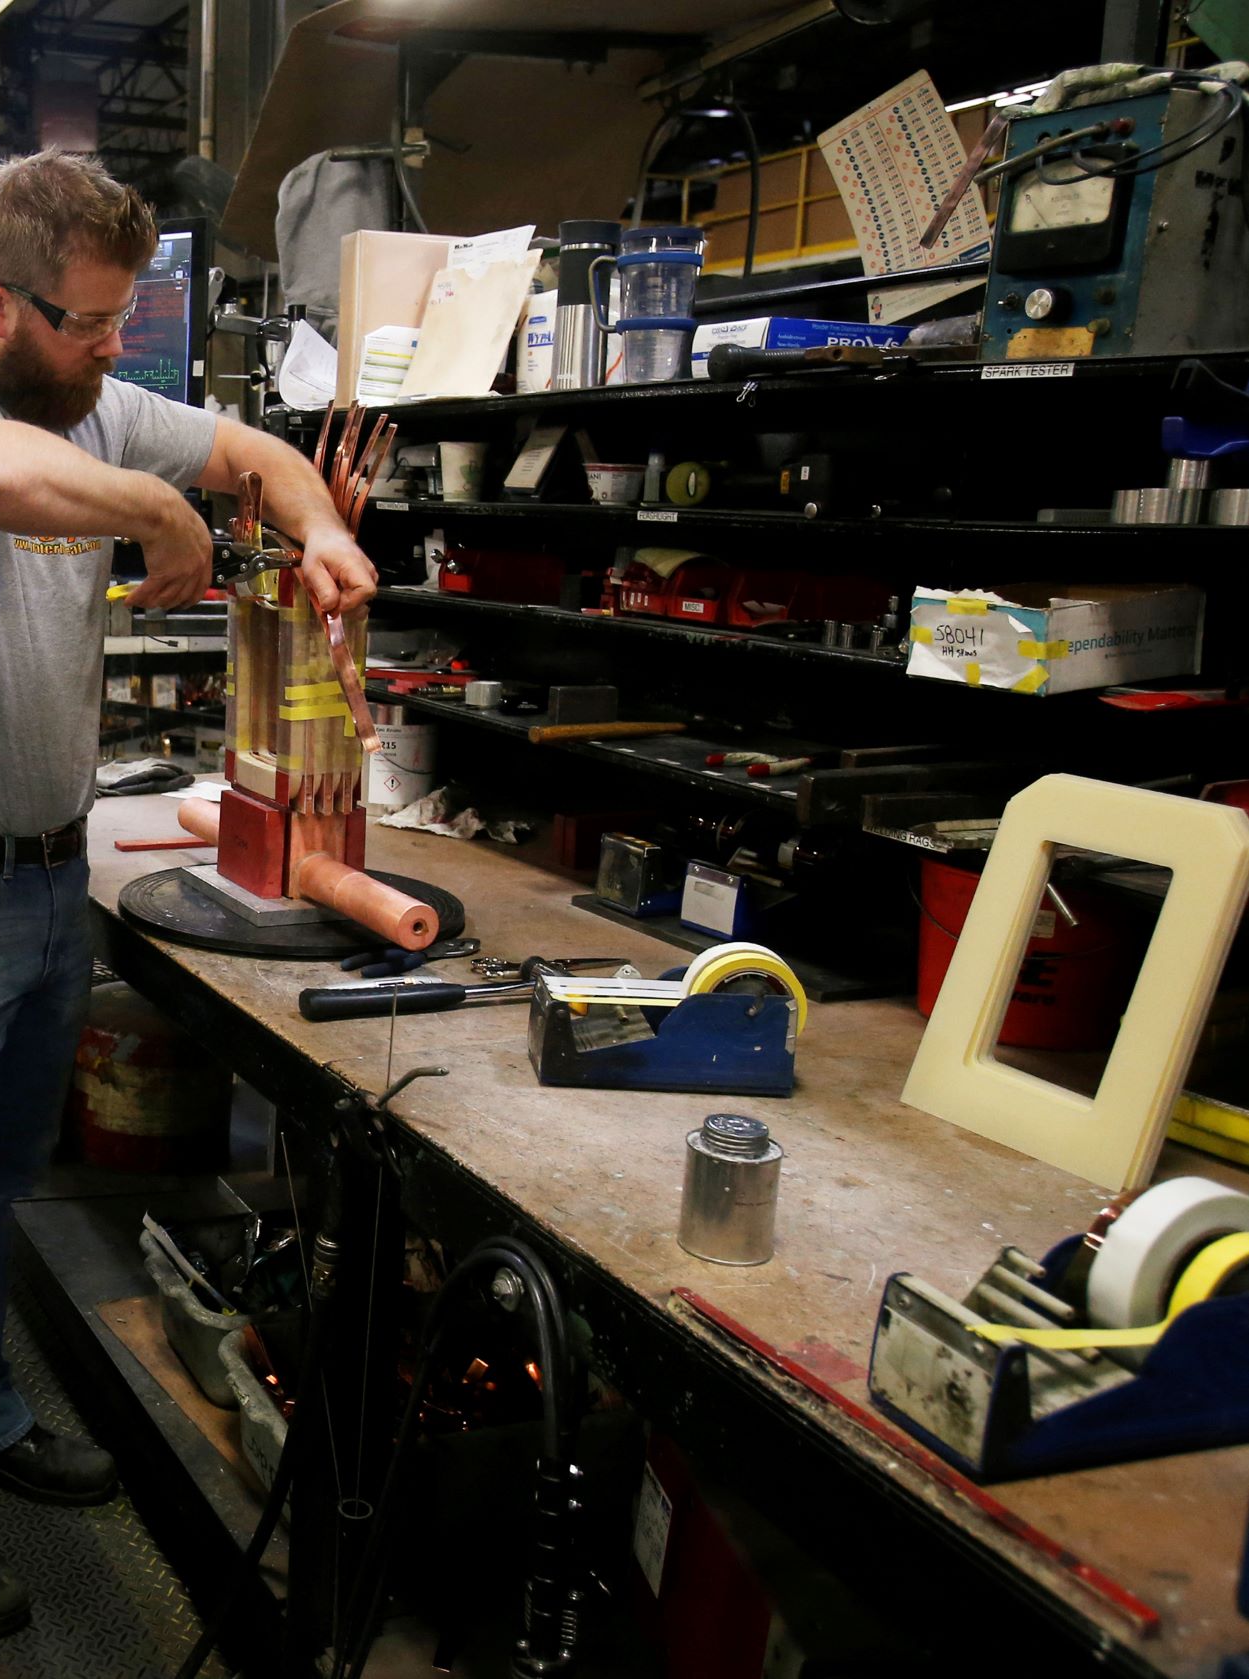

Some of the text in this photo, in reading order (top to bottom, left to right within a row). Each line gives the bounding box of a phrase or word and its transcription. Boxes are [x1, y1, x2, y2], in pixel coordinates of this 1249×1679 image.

[984, 364, 1069, 378] SPARK TESTER
[639, 511, 676, 521] FLASHLIGHT
[935, 625, 984, 647] 58041
[1148, 624, 1196, 641] Matters
